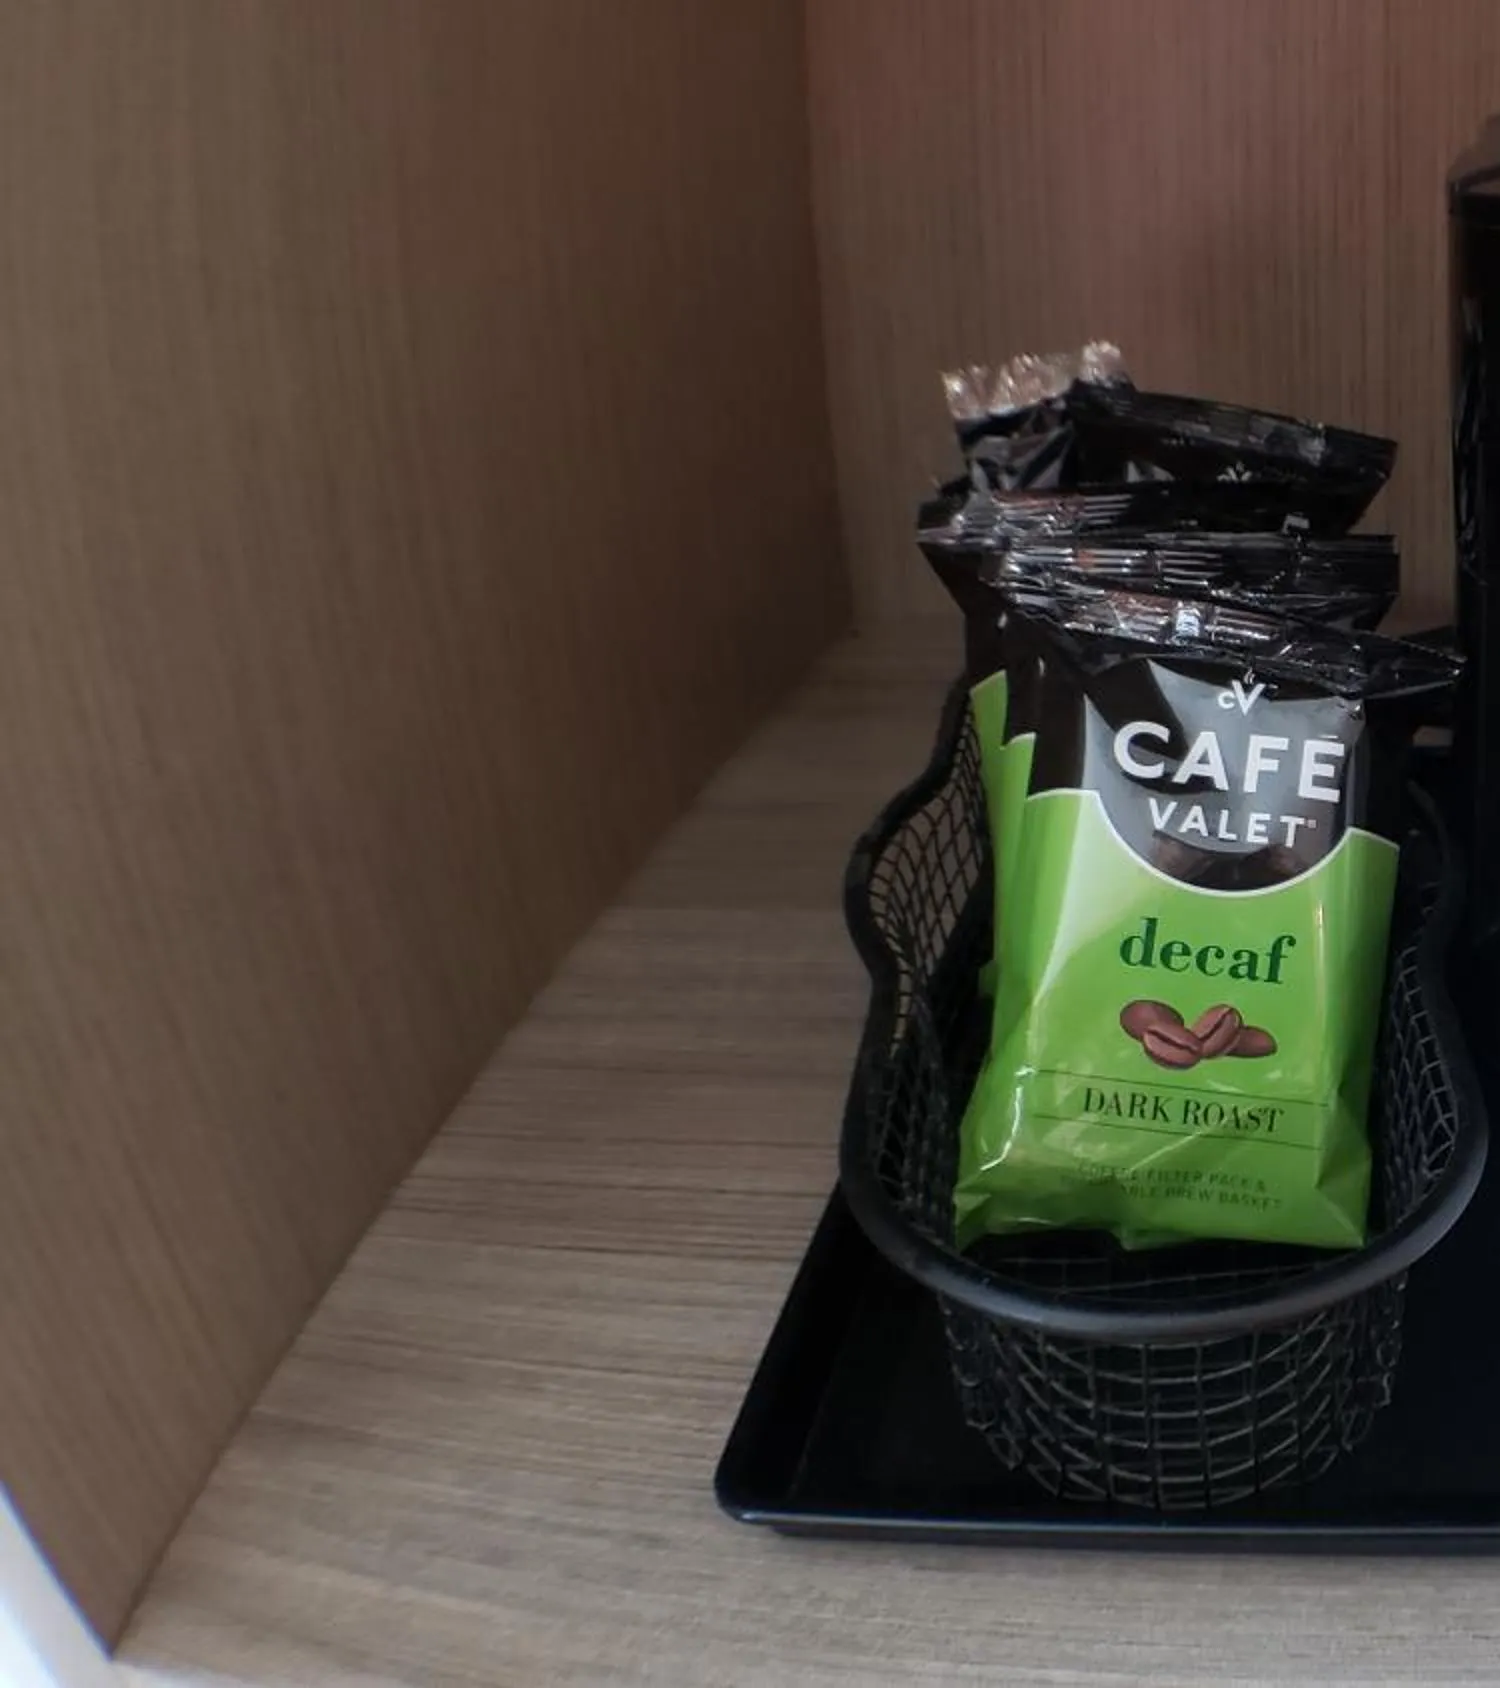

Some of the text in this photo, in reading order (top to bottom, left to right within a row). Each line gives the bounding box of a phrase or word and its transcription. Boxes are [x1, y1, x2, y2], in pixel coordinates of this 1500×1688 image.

[1119, 916, 1298, 985] decaf
[1083, 1087, 1285, 1133] DARK ROAST
